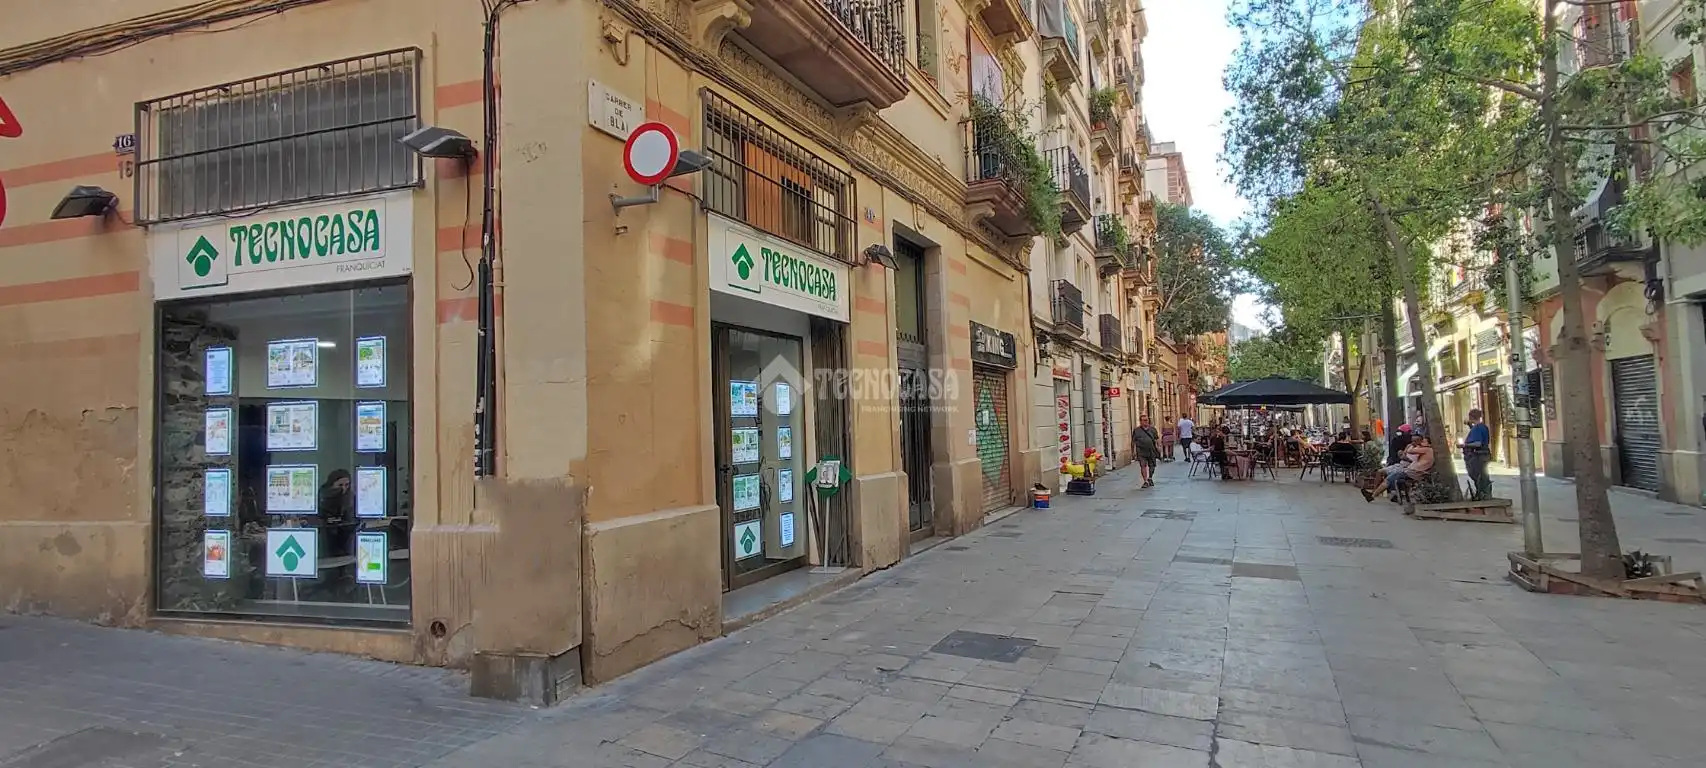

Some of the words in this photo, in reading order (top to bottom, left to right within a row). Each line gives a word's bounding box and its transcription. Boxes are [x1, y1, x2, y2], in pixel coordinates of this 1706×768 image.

[605, 92, 632, 111] CARRER
[614, 107, 624, 118] DE
[610, 115, 629, 134] BLAI
[118, 135, 132, 148] 16
[230, 209, 380, 267] TECNOCASA
[336, 260, 386, 273] FRANQUICIAT
[760, 246, 837, 302] TECNOCASA
